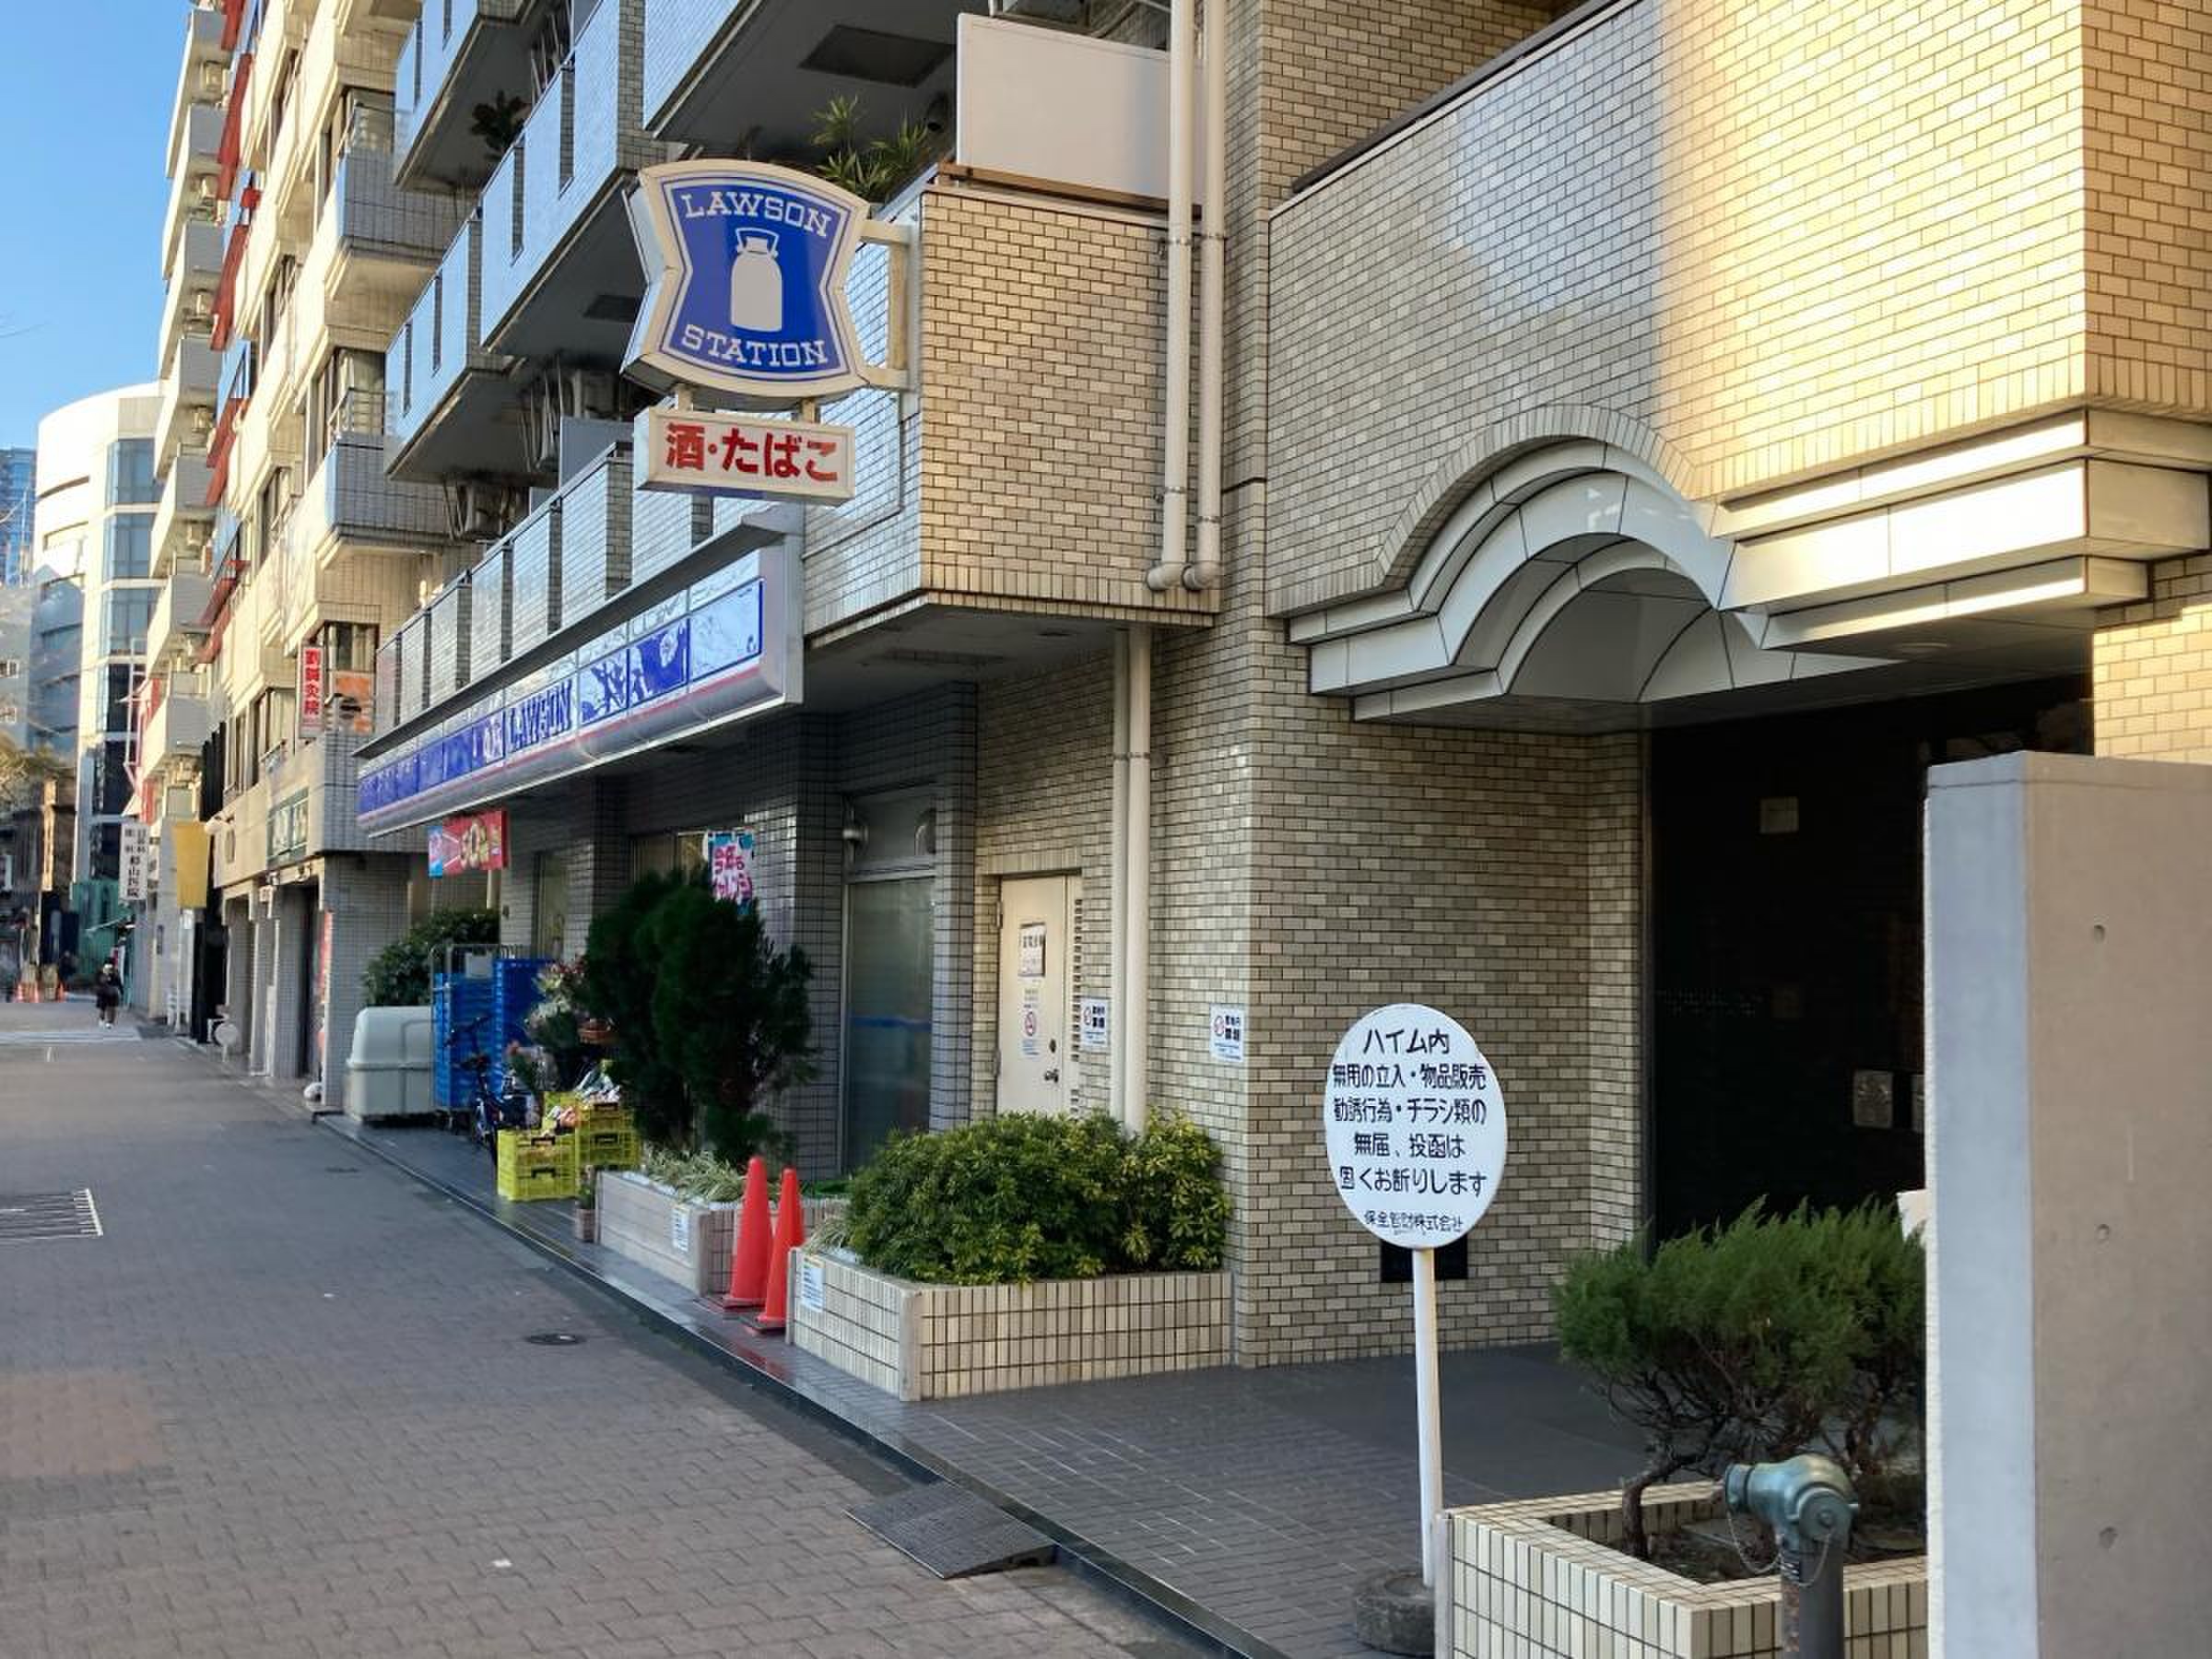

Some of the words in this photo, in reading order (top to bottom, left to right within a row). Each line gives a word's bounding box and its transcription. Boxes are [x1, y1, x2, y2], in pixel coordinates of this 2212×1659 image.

[681, 191, 832, 237] LAWSON
[681, 324, 829, 368] STATION
[665, 421, 839, 482] 酒・たばこ
[1362, 1028, 1450, 1054] ハイム内
[1333, 1063, 1487, 1091] 無用の立入・物品販売
[1333, 1097, 1487, 1124] 勧誘行為・チラシ類の
[1353, 1133, 1466, 1159] 無届、投函は
[1339, 1165, 1487, 1197] 固くお断りします
